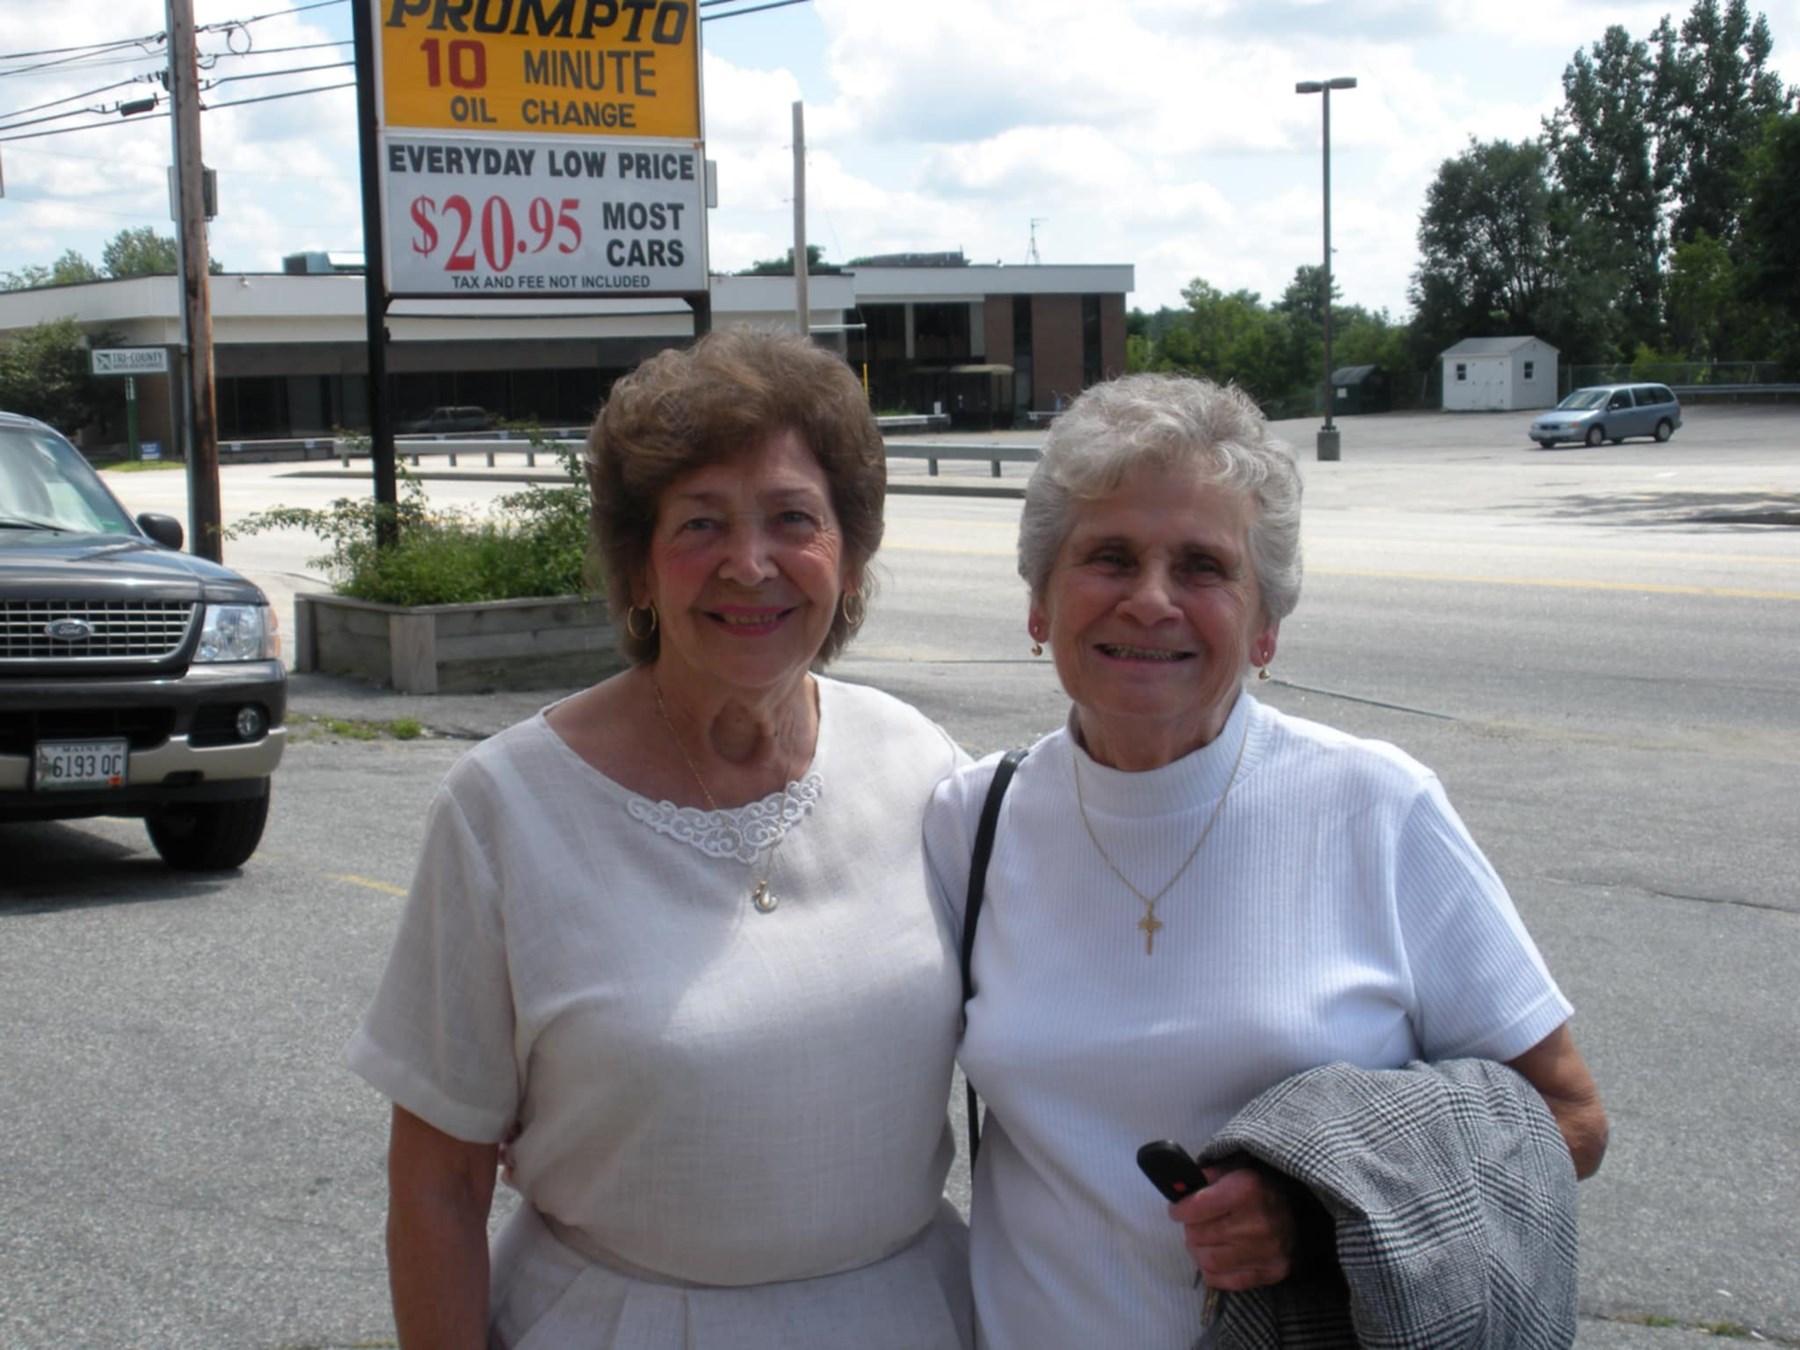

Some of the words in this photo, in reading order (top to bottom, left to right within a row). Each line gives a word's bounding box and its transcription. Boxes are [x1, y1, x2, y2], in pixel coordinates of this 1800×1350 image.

[385, 0, 689, 45] PROMPTO
[420, 38, 487, 89] 10
[524, 50, 657, 97] MINUTE
[451, 96, 497, 122] OIL
[521, 99, 636, 128] CHANGE
[388, 144, 535, 176] EVERYDAY
[549, 151, 606, 178] LOW
[618, 153, 694, 180] PRICE
[602, 202, 684, 231] MOST
[410, 195, 582, 272] $20.95
[606, 239, 684, 267] CARS
[452, 275, 479, 289] TAX
[484, 275, 514, 289] AND
[518, 275, 545, 289] FEE
[549, 275, 577, 289] NOT
[582, 275, 650, 289] INCLUDED
[53, 755, 96, 778] 6193
